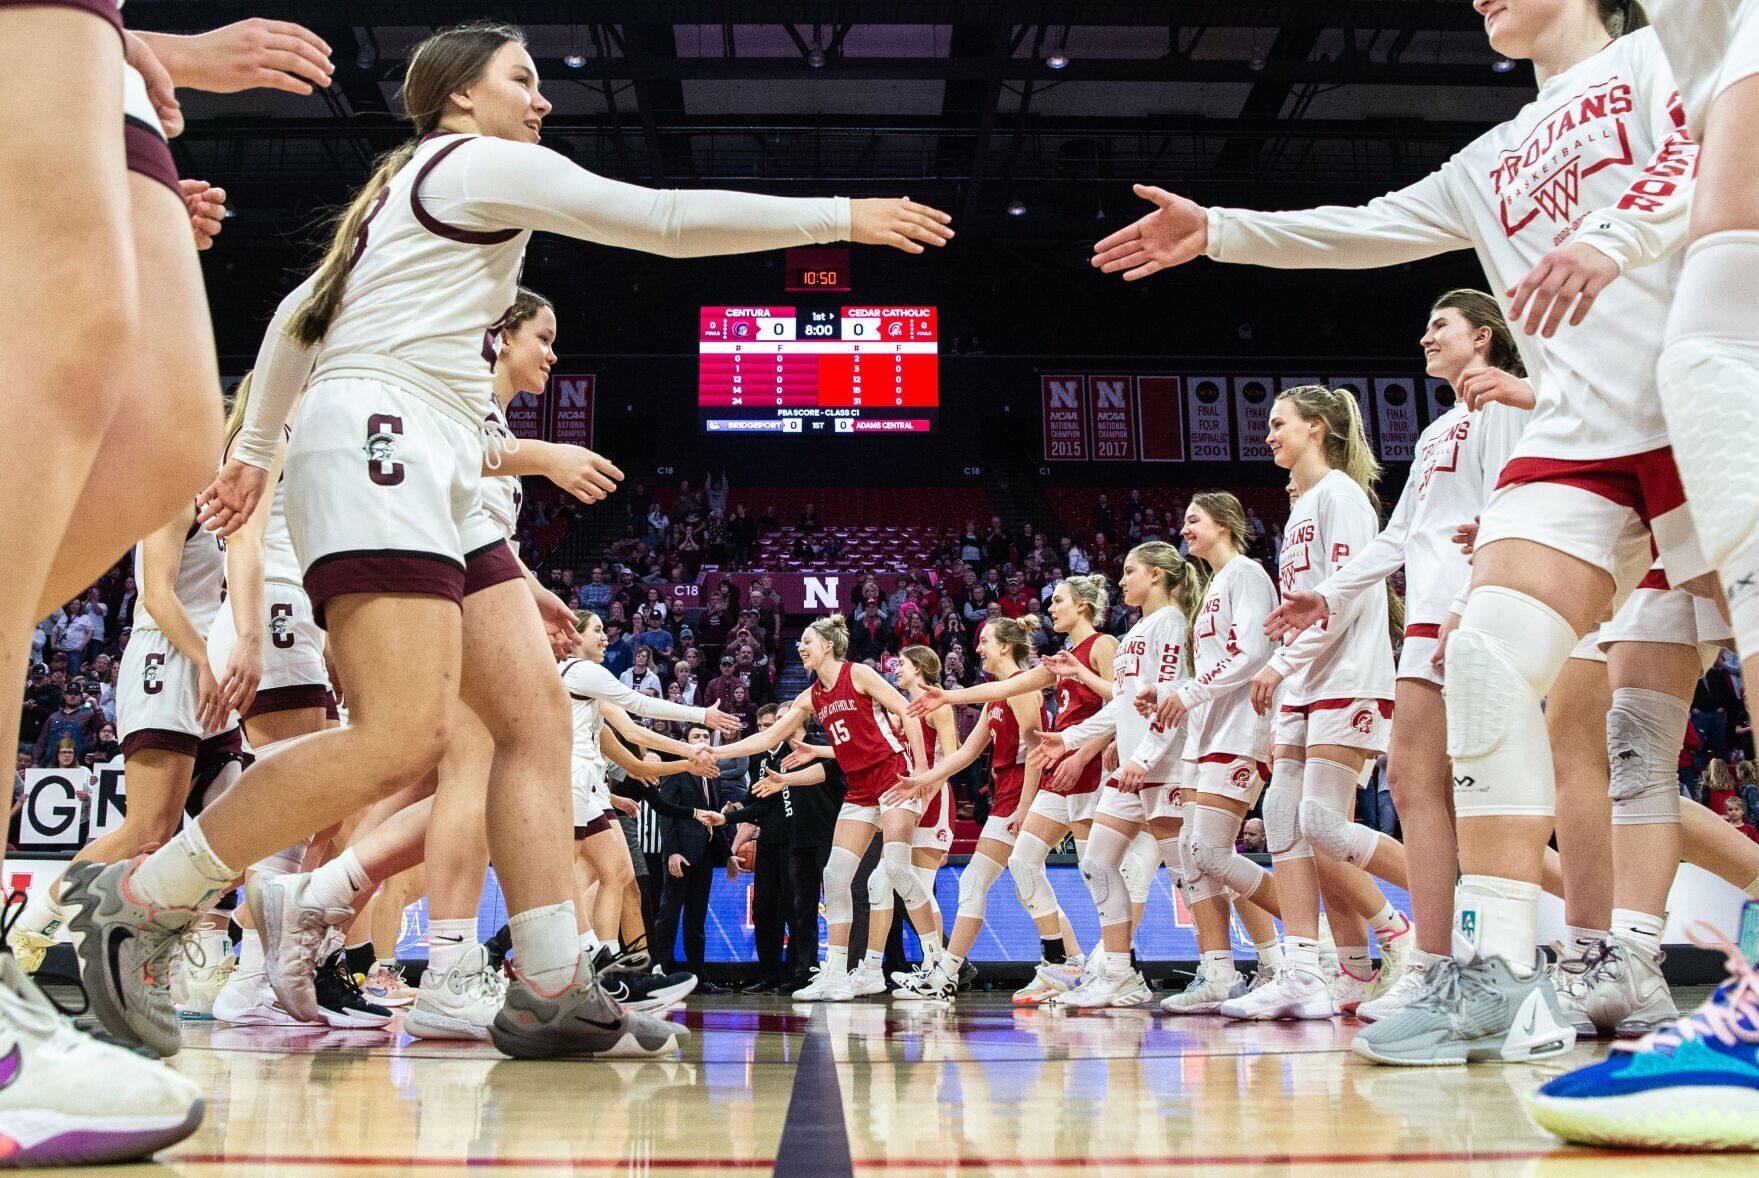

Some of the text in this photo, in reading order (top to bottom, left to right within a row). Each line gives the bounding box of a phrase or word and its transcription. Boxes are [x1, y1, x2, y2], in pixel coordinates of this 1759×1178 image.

[1489, 84, 1632, 195] TROJANS
[1507, 130, 1610, 205] BASKETBALL
[804, 272, 836, 284] 10:50
[725, 308, 771, 317] CENTURA
[848, 308, 930, 317] CEDAR CATHOLIC
[774, 323, 784, 336] 0
[805, 325, 834, 336] 8:00
[854, 324, 864, 336] 0
[736, 365, 740, 373] 1
[777, 365, 783, 373] 0
[896, 365, 902, 373] 0
[560, 381, 587, 407] N
[1049, 381, 1078, 408] N
[1096, 381, 1126, 408] N
[558, 411, 586, 419] NCAA
[1050, 412, 1078, 420] NCAA
[1097, 412, 1125, 420] NCAA
[1198, 406, 1220, 416] FINAL
[1245, 407, 1267, 418] FINAL
[1387, 409, 1409, 419] FINAL
[558, 421, 586, 429] NATIONAL
[1050, 422, 1079, 430] NATIONAL
[1098, 422, 1127, 430] NATIONAL
[1200, 420, 1219, 431] FOUR
[1248, 421, 1267, 431] FOUR
[1389, 422, 1409, 432] FOUR
[1190, 433, 1229, 443] SEMIFINALIST
[1382, 433, 1408, 442] RUNNER
[1051, 442, 1081, 456] 2015
[1098, 442, 1128, 456] 2017
[1194, 446, 1228, 456] 2001
[674, 586, 699, 596] C18
[803, 576, 839, 608] N
[829, 699, 857, 716] CATHOLIC
[829, 719, 851, 746] 15
[28, 775, 76, 837] G
